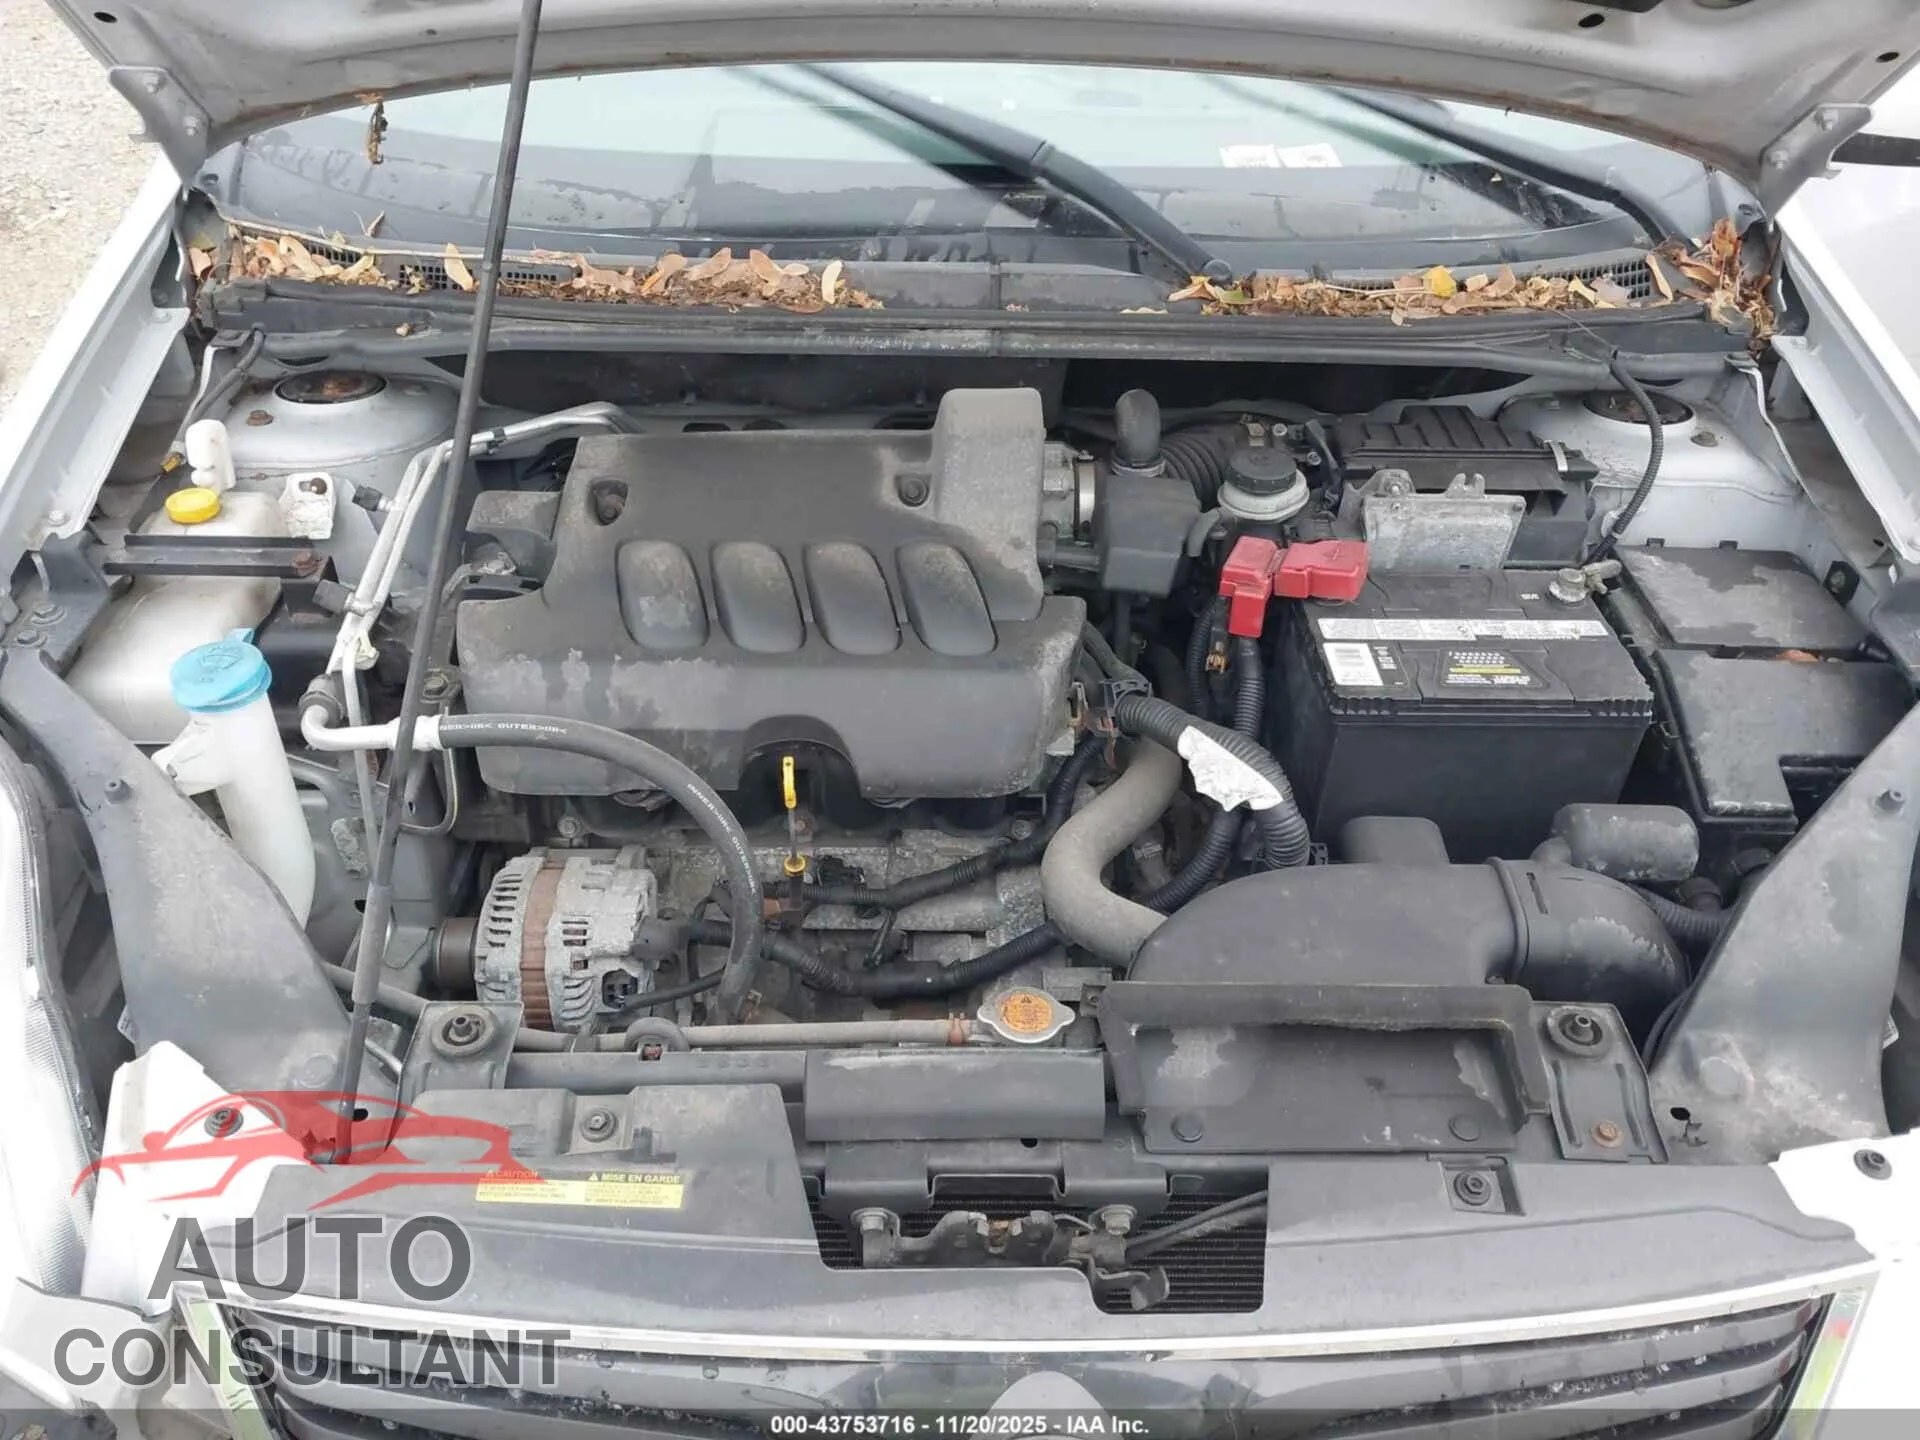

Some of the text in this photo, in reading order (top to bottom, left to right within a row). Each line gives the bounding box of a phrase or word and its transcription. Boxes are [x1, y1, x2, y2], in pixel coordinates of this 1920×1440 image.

[601, 1173, 680, 1184] MISE EN GARDE
